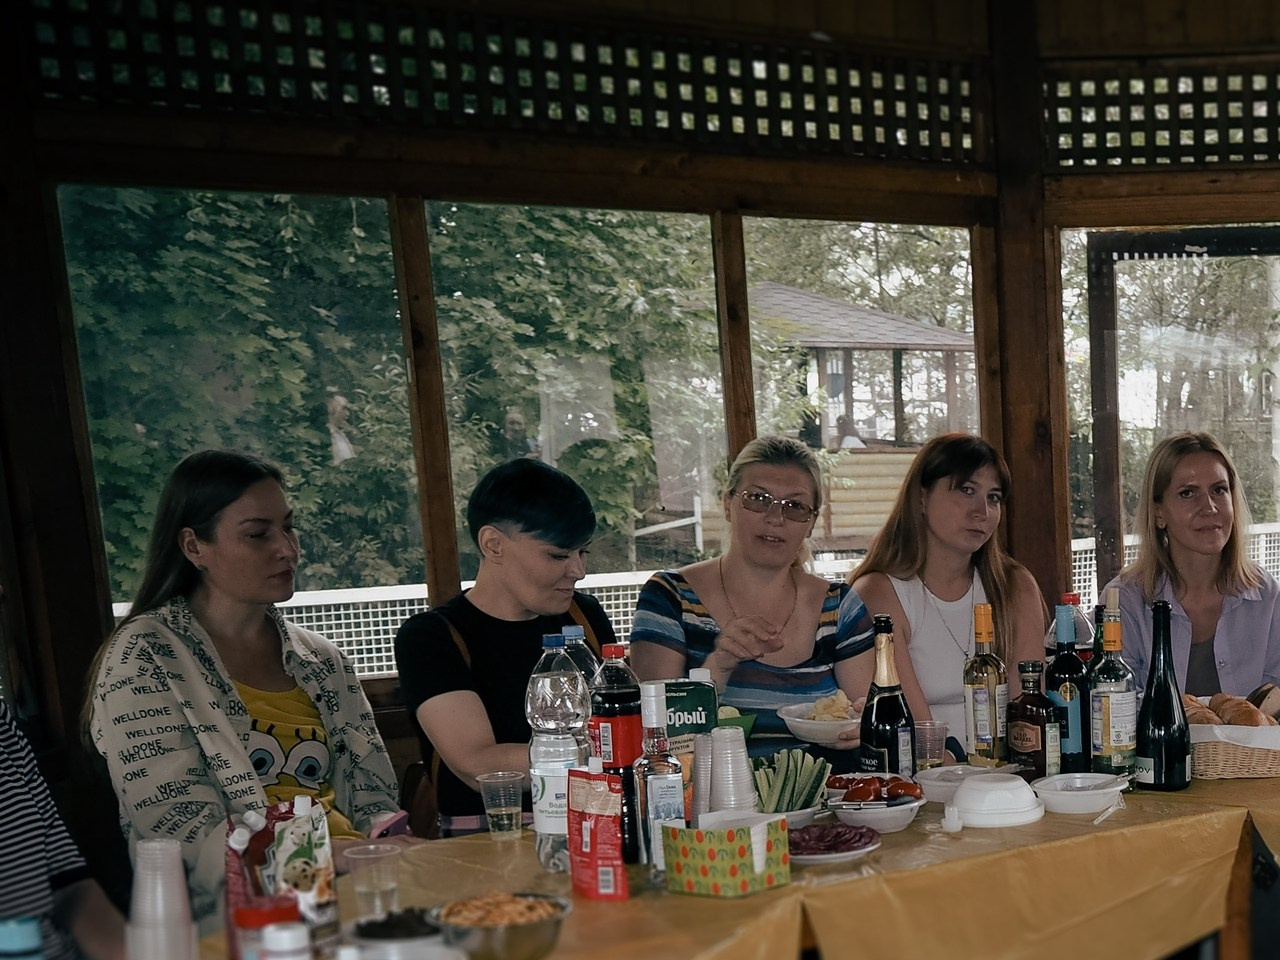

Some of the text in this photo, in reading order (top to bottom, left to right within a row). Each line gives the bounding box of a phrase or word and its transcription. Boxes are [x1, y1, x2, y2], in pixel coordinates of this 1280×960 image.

[112, 706, 172, 726] WELLDONE
[667, 706, 707, 727] брый
[125, 724, 187, 740] WELLDONE
[133, 786, 191, 811] WELLDONE
